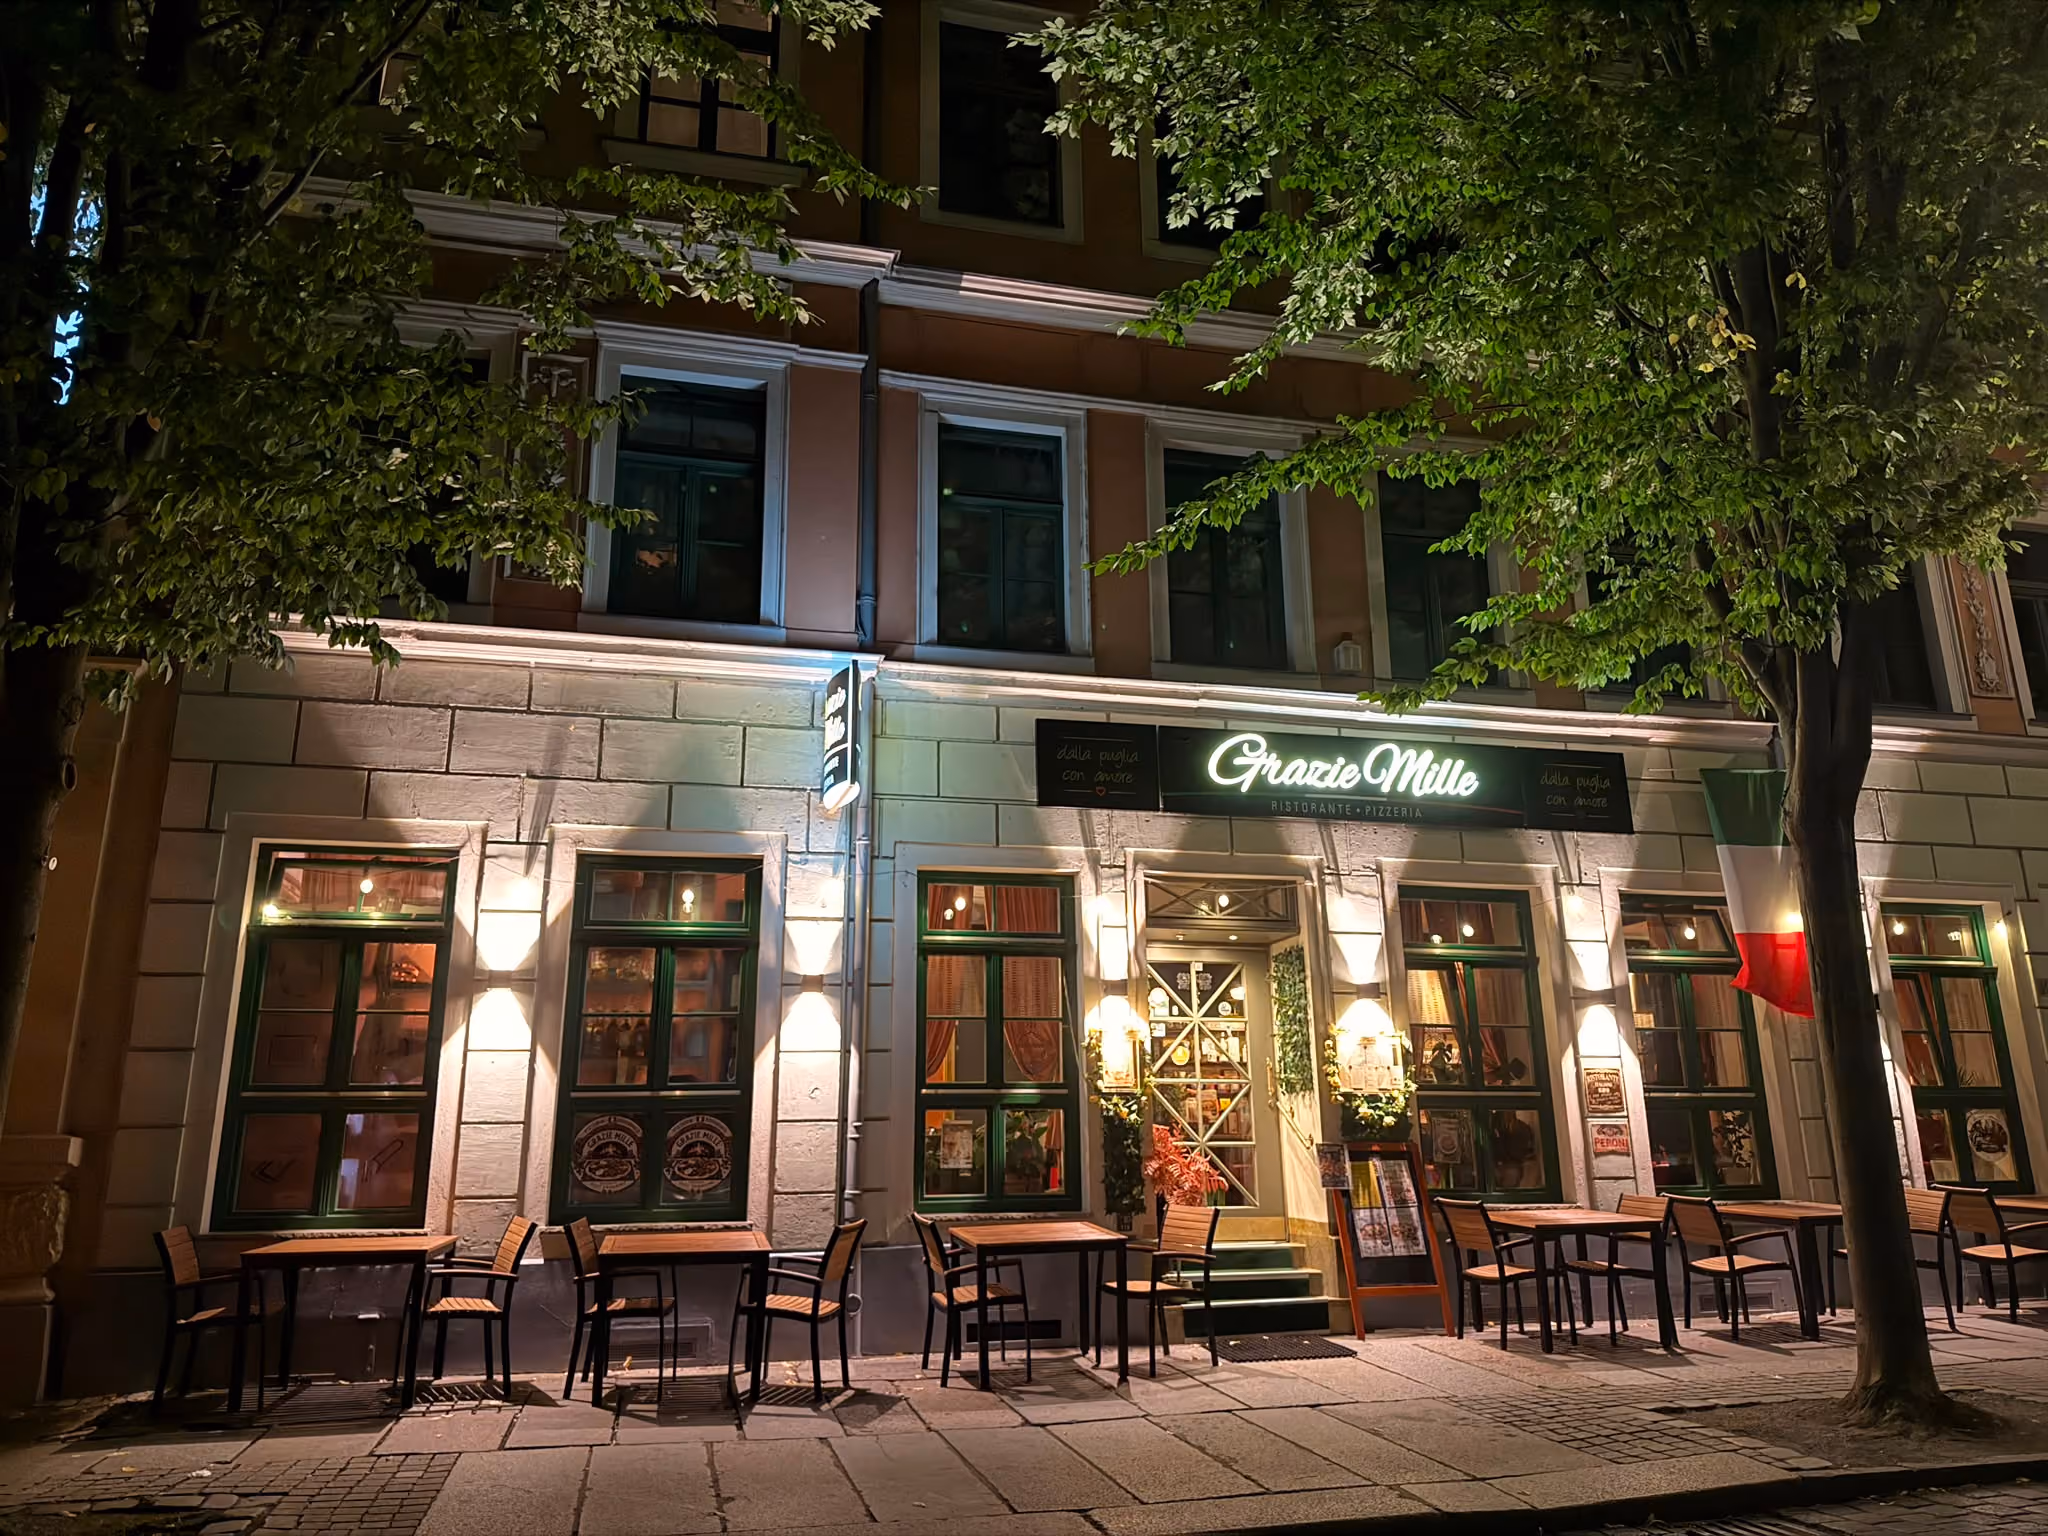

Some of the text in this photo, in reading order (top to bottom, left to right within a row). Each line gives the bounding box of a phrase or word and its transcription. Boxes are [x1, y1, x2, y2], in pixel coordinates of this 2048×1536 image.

[1056, 744, 1139, 769] dalla puglia
[1208, 733, 1479, 797] Grazie Mille
[1062, 769, 1134, 784] con amore
[1540, 767, 1612, 794] dalla puglia
[1546, 793, 1568, 806] con
[1271, 800, 1423, 819] RISTORANTE PIZZERIA
[1594, 1137, 1628, 1147] PERONI
